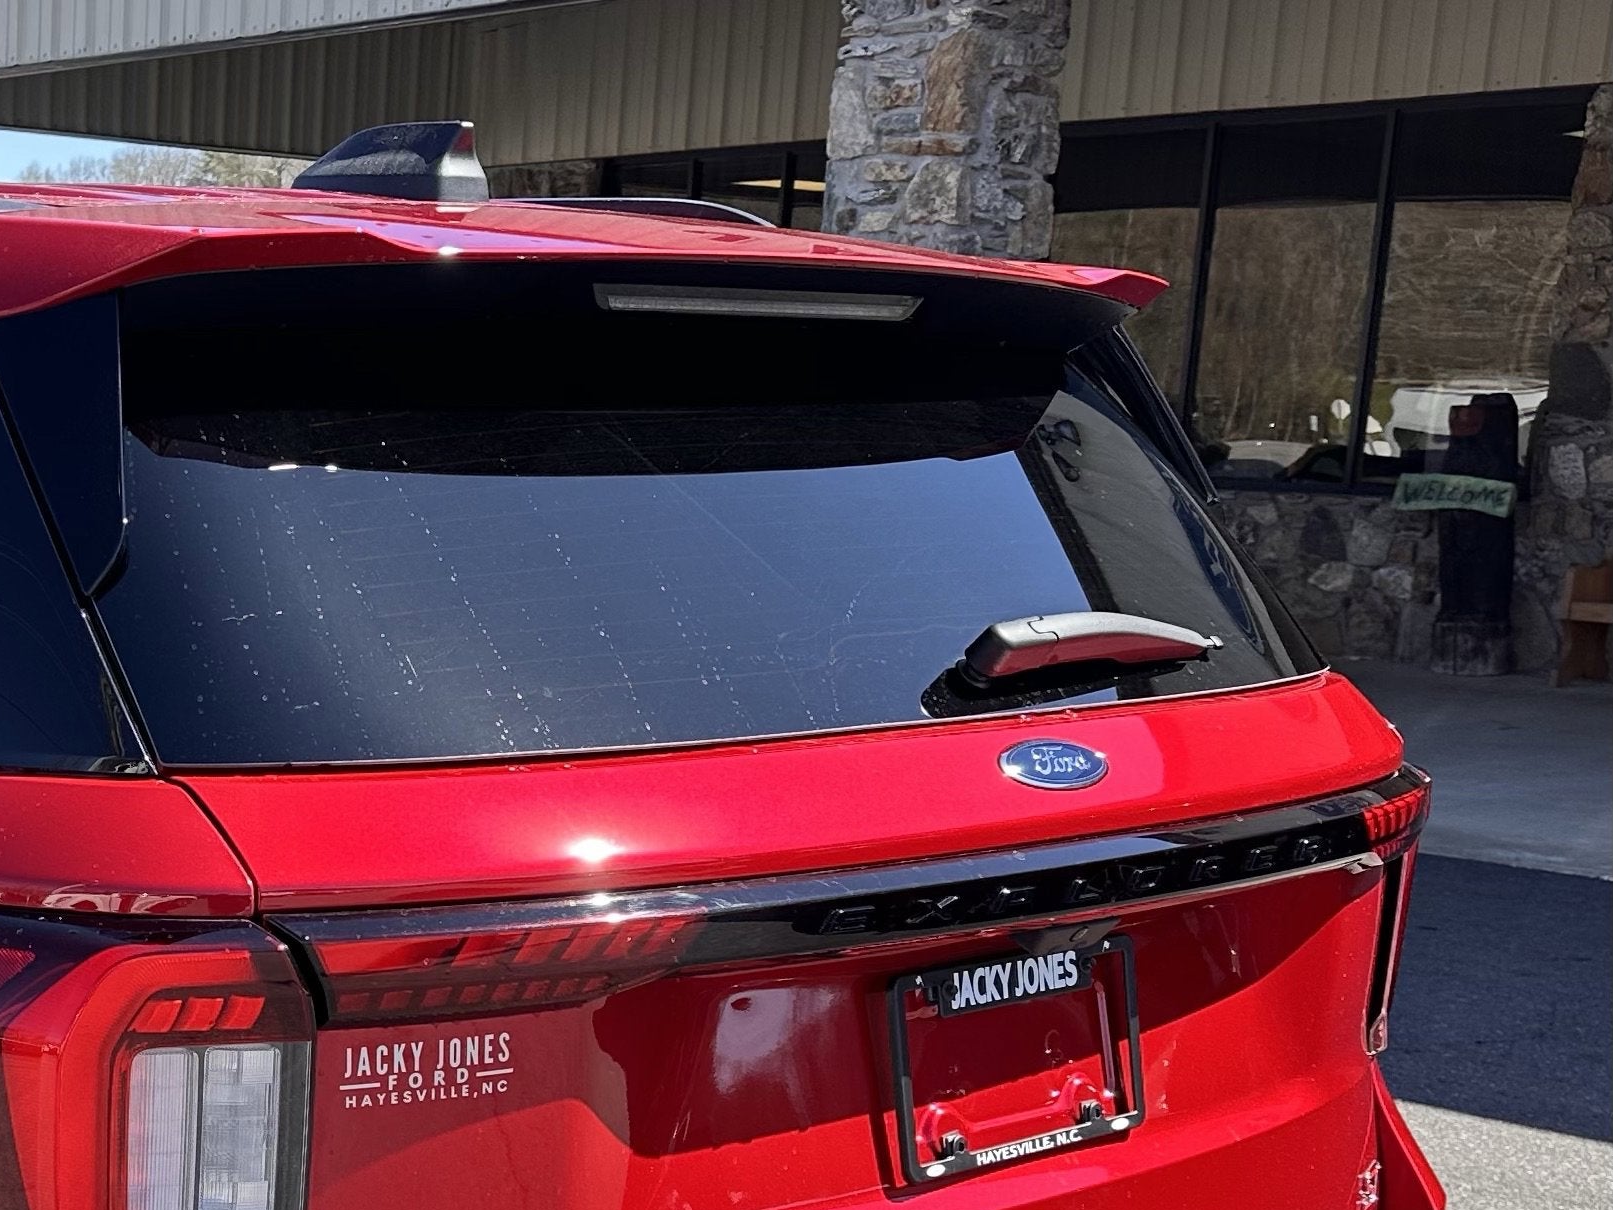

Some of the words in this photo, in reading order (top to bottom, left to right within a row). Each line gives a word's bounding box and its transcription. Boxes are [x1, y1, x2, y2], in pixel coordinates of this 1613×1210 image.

[1402, 481, 1509, 508] WELCOME
[1030, 745, 1092, 776] Ford
[950, 961, 1013, 1010] JACKY
[1014, 950, 1078, 997] JONES
[344, 1041, 424, 1079] JACKY
[436, 1031, 511, 1069] JONES
[387, 1067, 470, 1092] FORD
